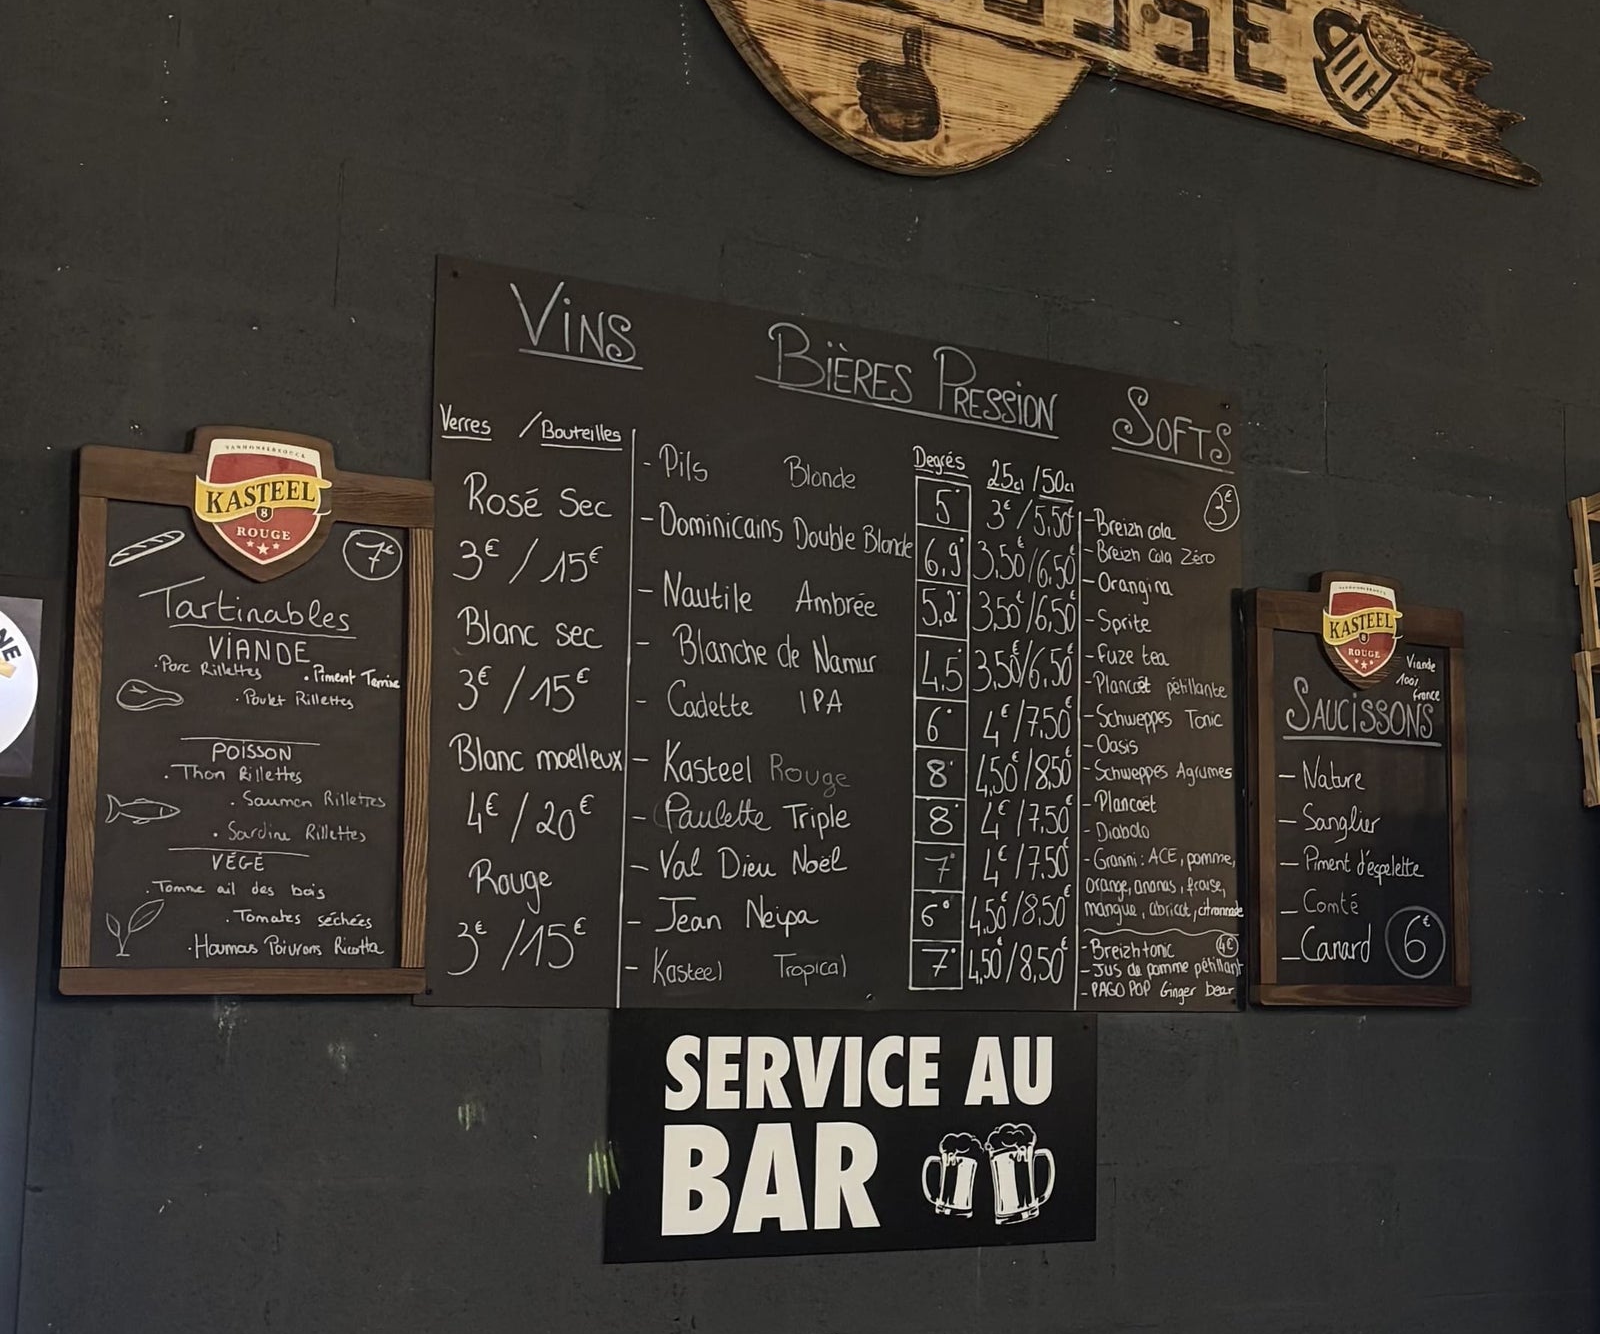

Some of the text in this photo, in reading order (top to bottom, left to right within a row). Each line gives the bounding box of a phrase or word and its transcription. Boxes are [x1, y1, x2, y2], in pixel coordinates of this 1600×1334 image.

[440, 403, 492, 435] Verres
[659, 444, 856, 489] Pils Blonde
[913, 445, 965, 474] Degrés
[205, 481, 316, 515] KASTEEL
[464, 472, 542, 518] Rosé
[236, 526, 291, 542] ROUGE
[660, 502, 913, 559] Dominicains Double Blonde
[1093, 508, 1143, 538] Breizh
[1096, 539, 1140, 564] Breizh
[664, 570, 877, 617] Nautile Ambrée
[1098, 572, 1173, 605] Orangina
[139, 577, 350, 631] Tartinables
[457, 606, 538, 647] Blanc
[1098, 609, 1151, 635] Sprite
[1329, 612, 1395, 640] KASTEEL
[672, 623, 877, 674] Blanche de Namur
[1142, 646, 1169, 666] tea
[1348, 647, 1381, 659] ROUGE
[160, 655, 261, 680] Porc Rillettes
[314, 666, 356, 687] Piment
[244, 689, 354, 709] Poulet Rillettes
[667, 679, 843, 718] Cadette IPA
[1097, 704, 1223, 733] Schweppes Tonic
[449, 733, 623, 772] Blanc moelleux
[1097, 735, 1138, 755] Oasis
[181, 765, 303, 785] Thon Rillettes
[663, 739, 851, 797] Kasteel Rouge
[1095, 759, 1232, 787] Schweppes Agrumes
[1303, 755, 1365, 791] Nature
[242, 792, 386, 809] Saumon Rillettes
[665, 792, 851, 840] Paulette Triple
[1303, 807, 1380, 843] Sanglier
[227, 822, 366, 843] Sardine Rillettes
[1096, 821, 1150, 842] Diabolo
[660, 840, 848, 880] Val Dieu Noël
[1304, 844, 1350, 874] Piment
[152, 880, 326, 901] Tomme ail des bois
[469, 858, 552, 914] Rouge
[233, 909, 301, 925] Tomates
[655, 895, 819, 937] Jean Neipa
[1303, 888, 1359, 916] Comté
[1090, 938, 1140, 960] Breizh
[1301, 923, 1371, 962] Canard
[652, 947, 847, 986] Kasteel Tropical
[1091, 982, 1125, 999] PAGO
[1160, 981, 1196, 1005] Ginger
[665, 1035, 1053, 1111] SERVICE AU
[661, 1122, 881, 1236] BAR
